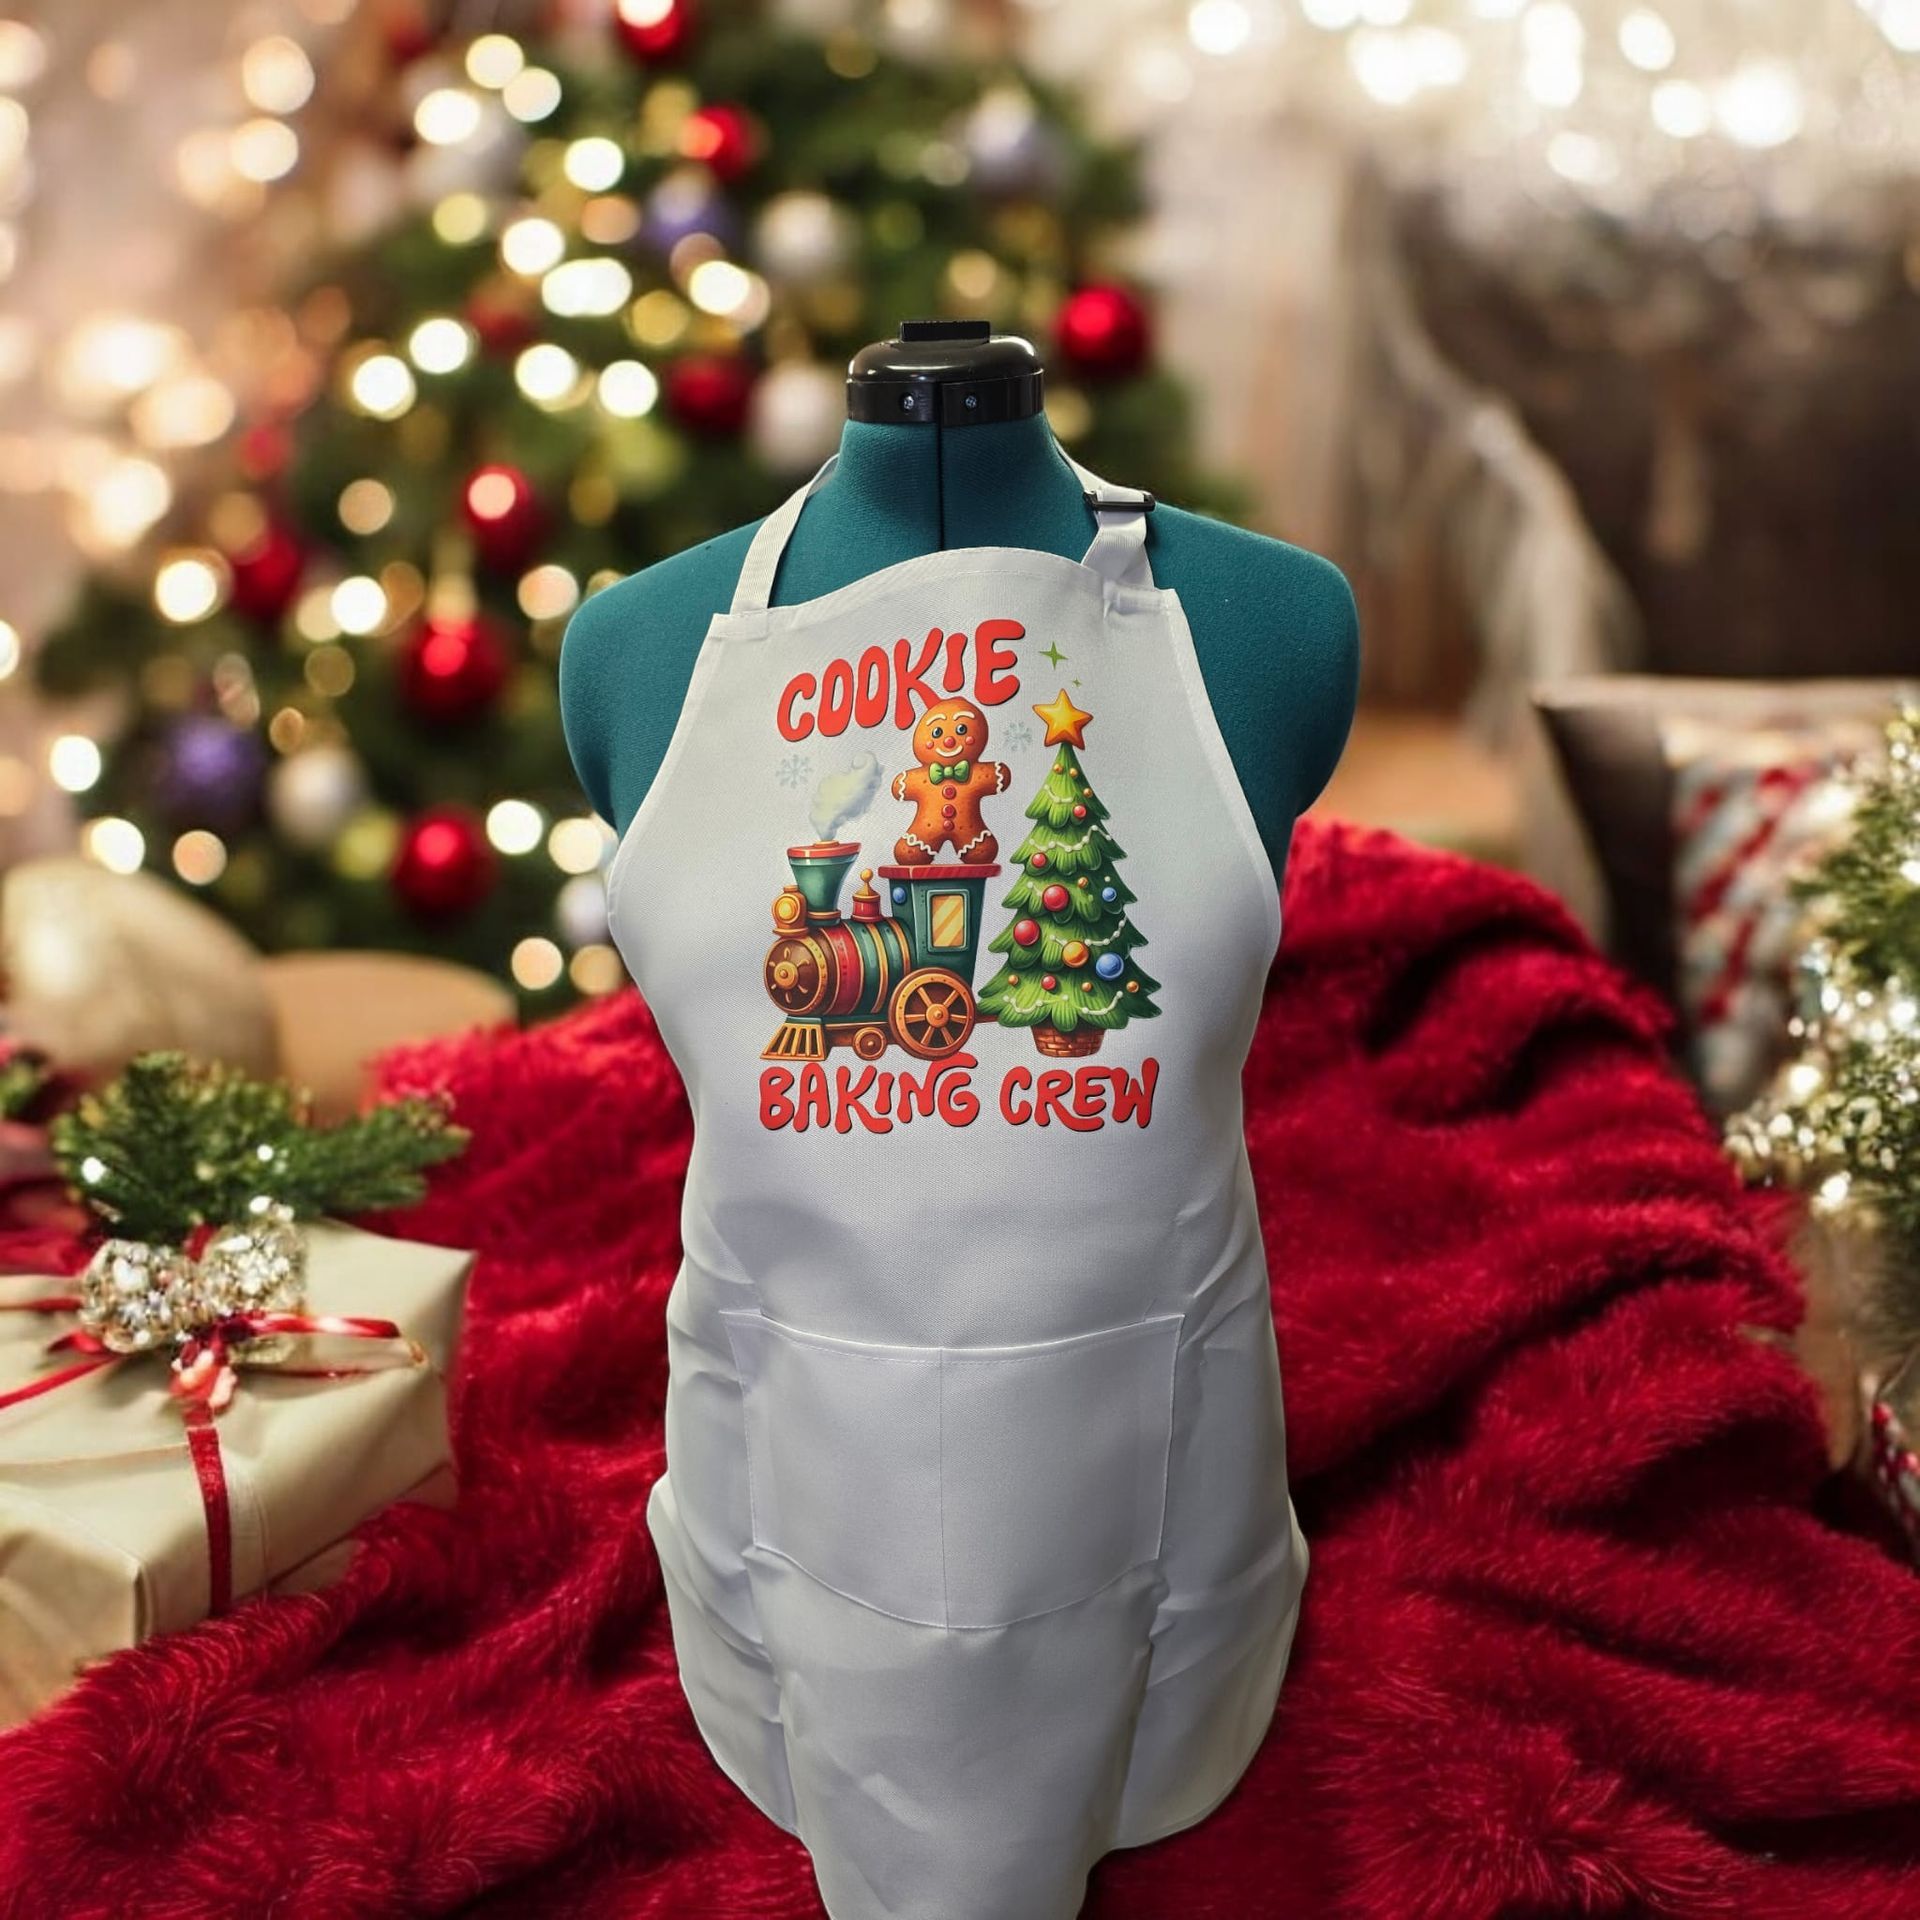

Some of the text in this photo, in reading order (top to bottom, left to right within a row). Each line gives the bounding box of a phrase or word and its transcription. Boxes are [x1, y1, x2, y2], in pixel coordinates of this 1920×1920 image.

[776, 619, 1026, 742] COOKIE
[759, 1051, 1160, 1134] BAKING CREW
